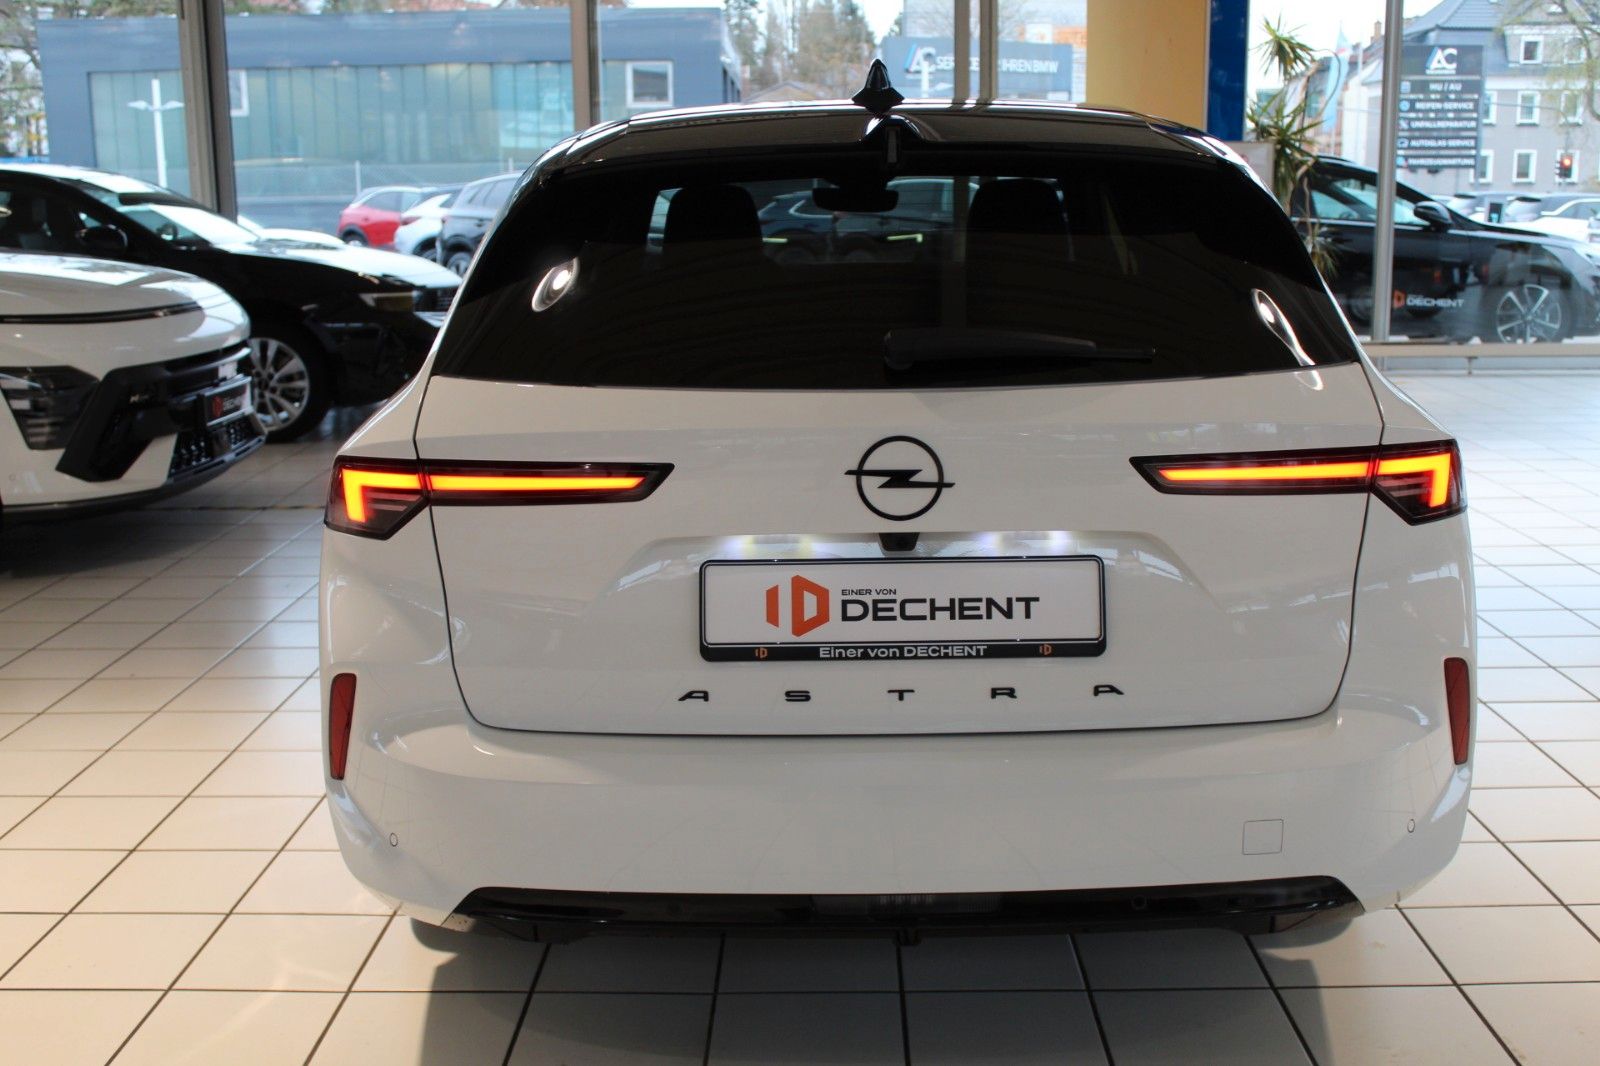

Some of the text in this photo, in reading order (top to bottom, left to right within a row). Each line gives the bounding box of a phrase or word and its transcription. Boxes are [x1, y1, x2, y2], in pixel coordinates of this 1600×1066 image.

[1032, 59, 1059, 73] BMW
[1406, 296, 1464, 307] DECHENT
[841, 588, 872, 596] EINER
[841, 597, 1040, 622] DECHENT
[819, 645, 987, 659] Einer von DECHENT
